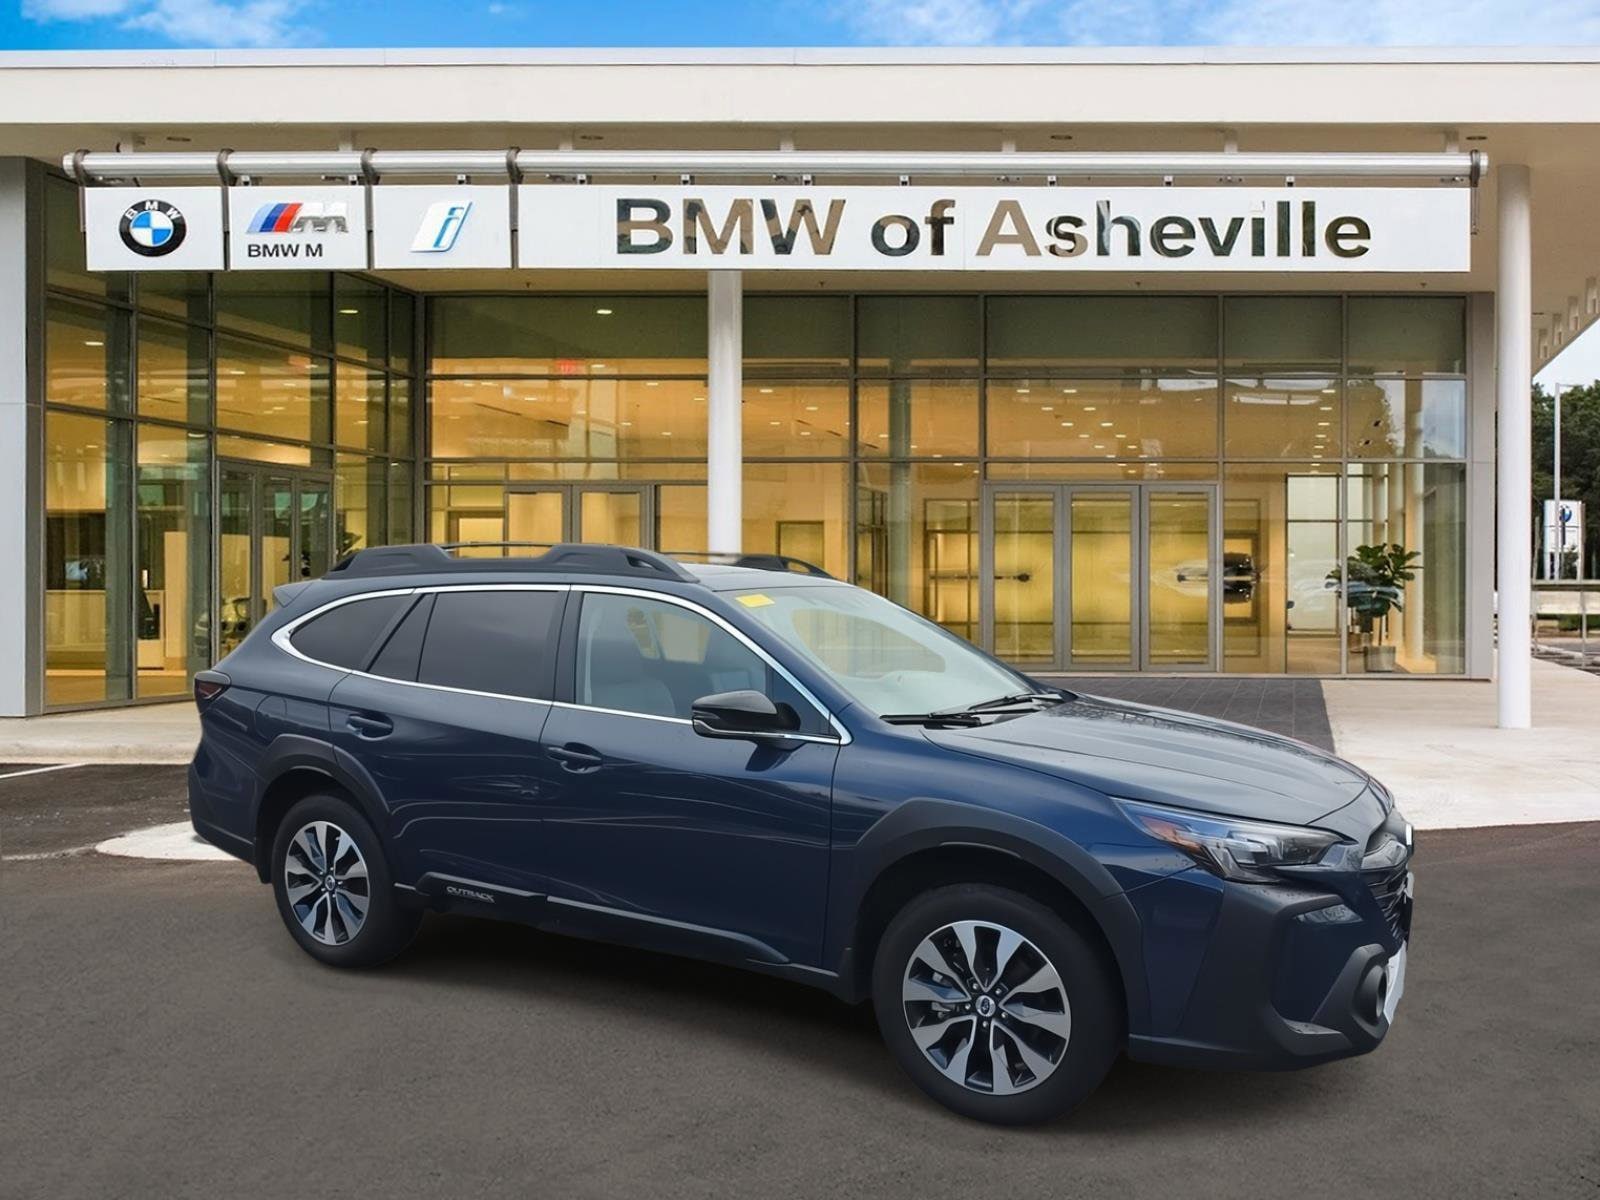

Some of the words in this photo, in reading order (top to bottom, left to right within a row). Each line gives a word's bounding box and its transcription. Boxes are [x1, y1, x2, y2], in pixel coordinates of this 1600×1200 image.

[125, 200, 181, 220] BMW
[616, 198, 846, 256] BMW
[871, 198, 956, 258] of
[976, 199, 1372, 259] Asheville
[247, 244, 300, 258] BMW
[305, 243, 323, 258] M
